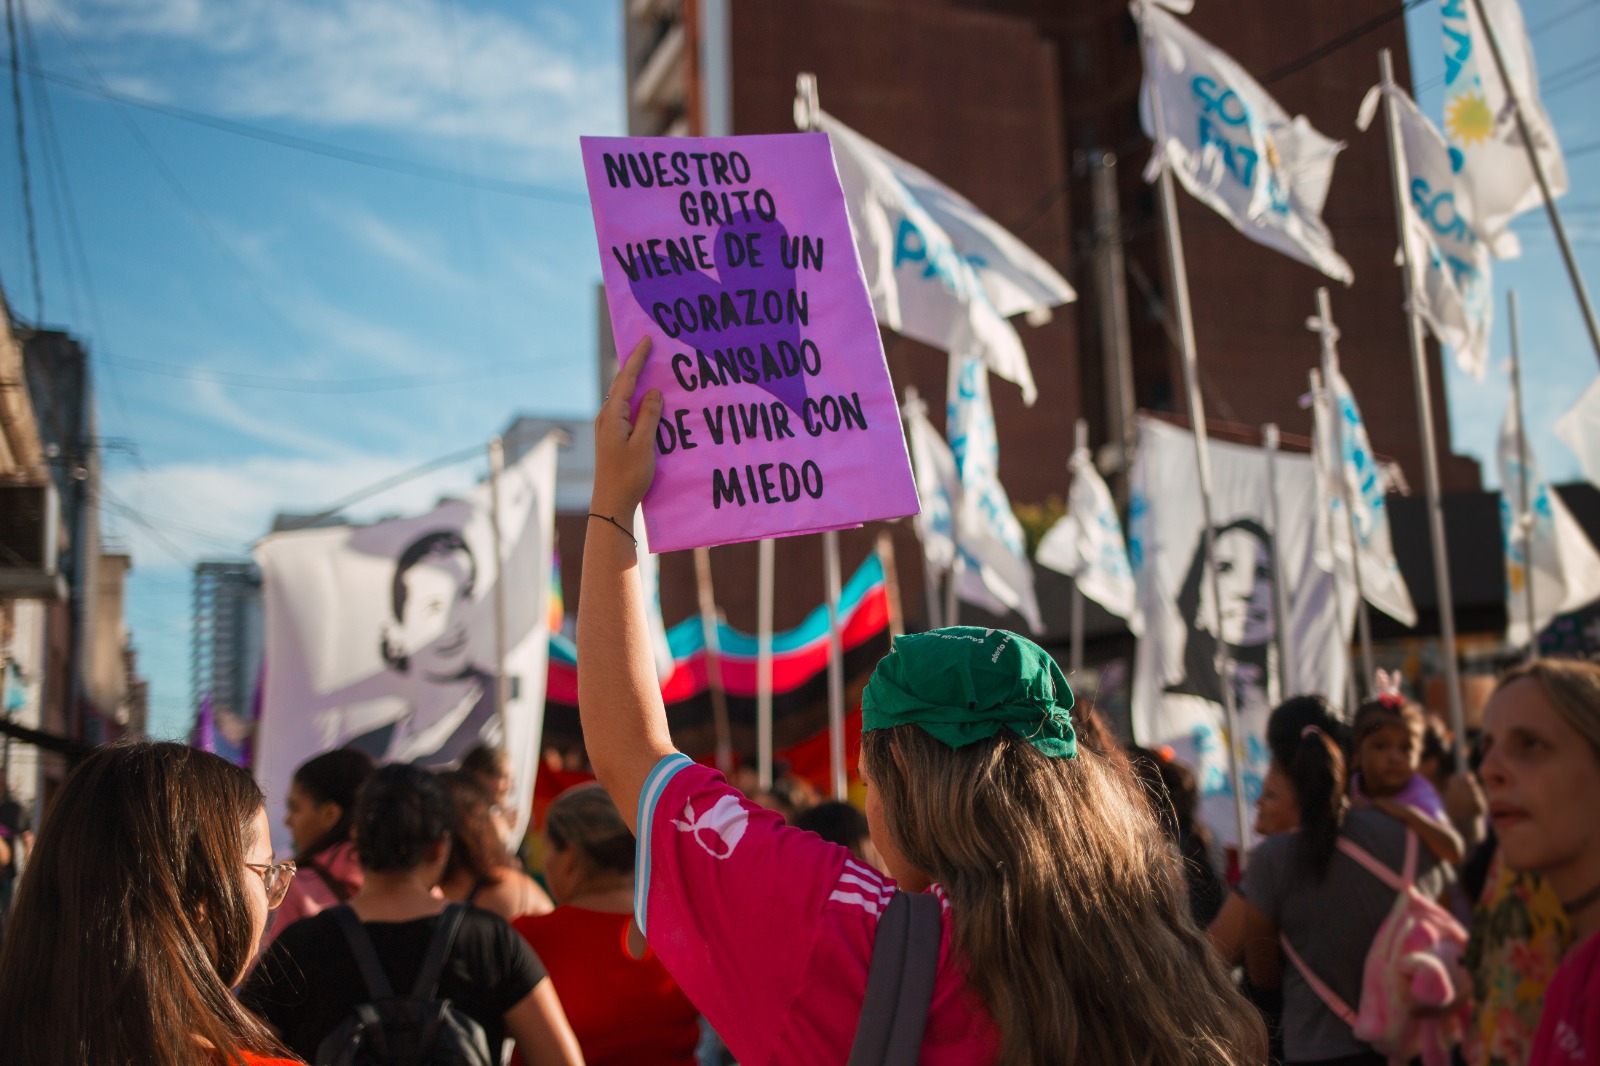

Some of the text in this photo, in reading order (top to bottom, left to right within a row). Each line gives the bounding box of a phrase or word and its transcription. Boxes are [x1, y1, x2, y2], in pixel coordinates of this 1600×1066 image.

[603, 151, 751, 188] NUESTRO
[679, 188, 776, 227] GRITO
[612, 231, 823, 282] VIENE DE UN
[652, 288, 808, 339] CORAZON
[671, 339, 821, 392] CANSADO
[656, 392, 868, 455] DE VIVIR CON
[712, 459, 823, 509] MIEDO
